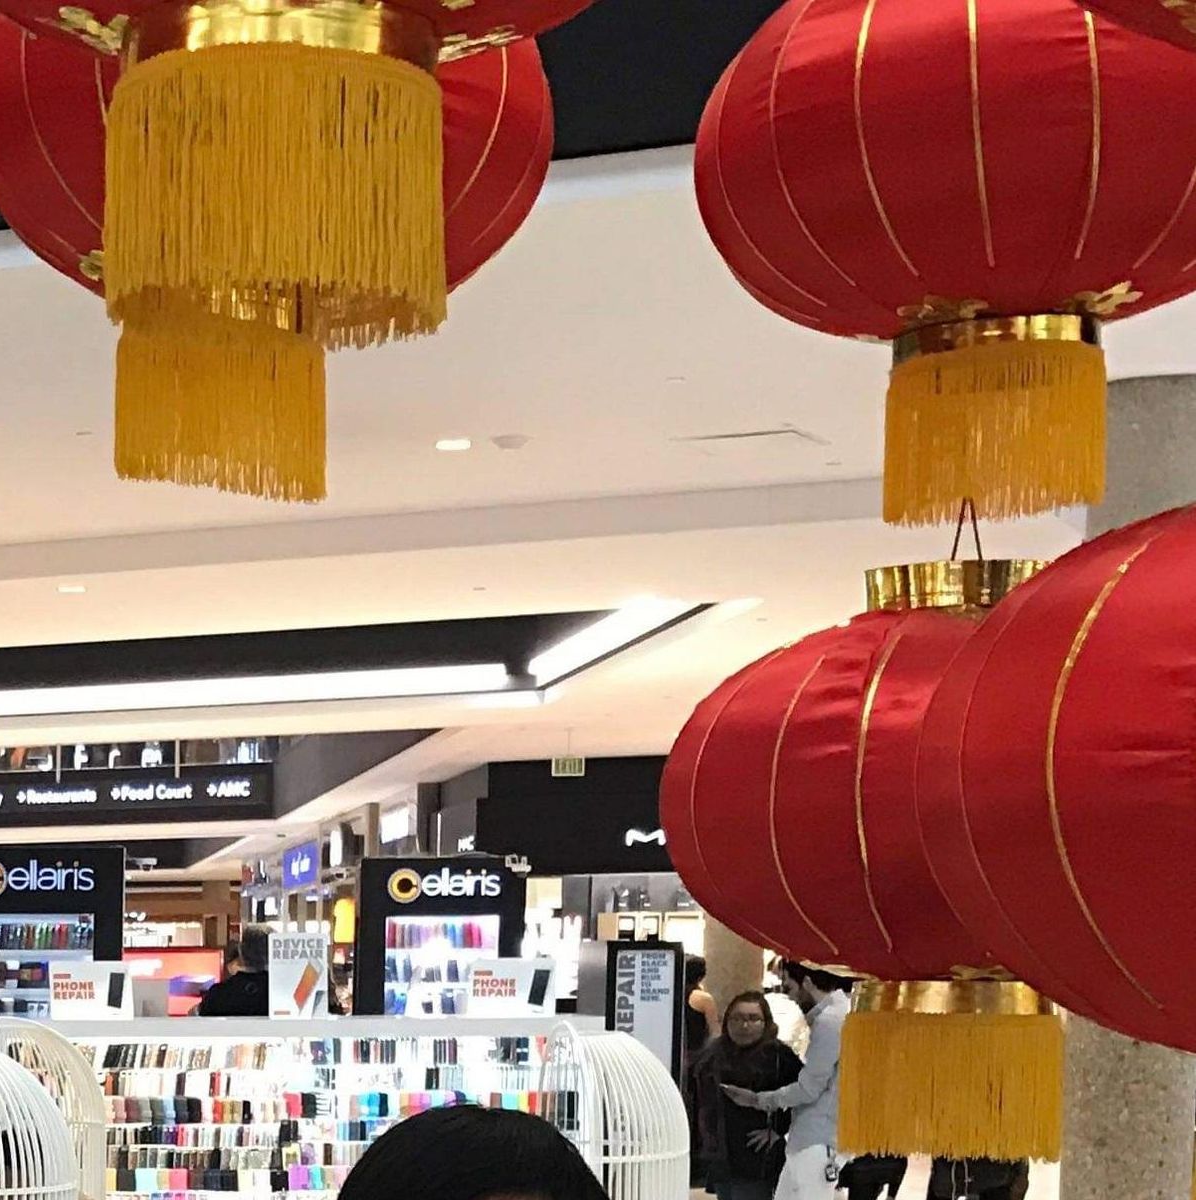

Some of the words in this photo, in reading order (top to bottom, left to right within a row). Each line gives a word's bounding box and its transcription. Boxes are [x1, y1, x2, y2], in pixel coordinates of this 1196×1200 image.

[120, 784, 154, 801] Food
[155, 783, 193, 800] Court
[217, 780, 251, 797] AMC
[26, 788, 97, 805] Restaurants
[387, 867, 502, 904] Cellairis
[272, 938, 324, 949] DEVICE
[272, 949, 323, 960] REPAIR
[53, 981, 94, 991] PHONE
[473, 978, 517, 988] PHONE
[53, 991, 96, 1000] REPAIR
[472, 988, 517, 997] REPAIR
